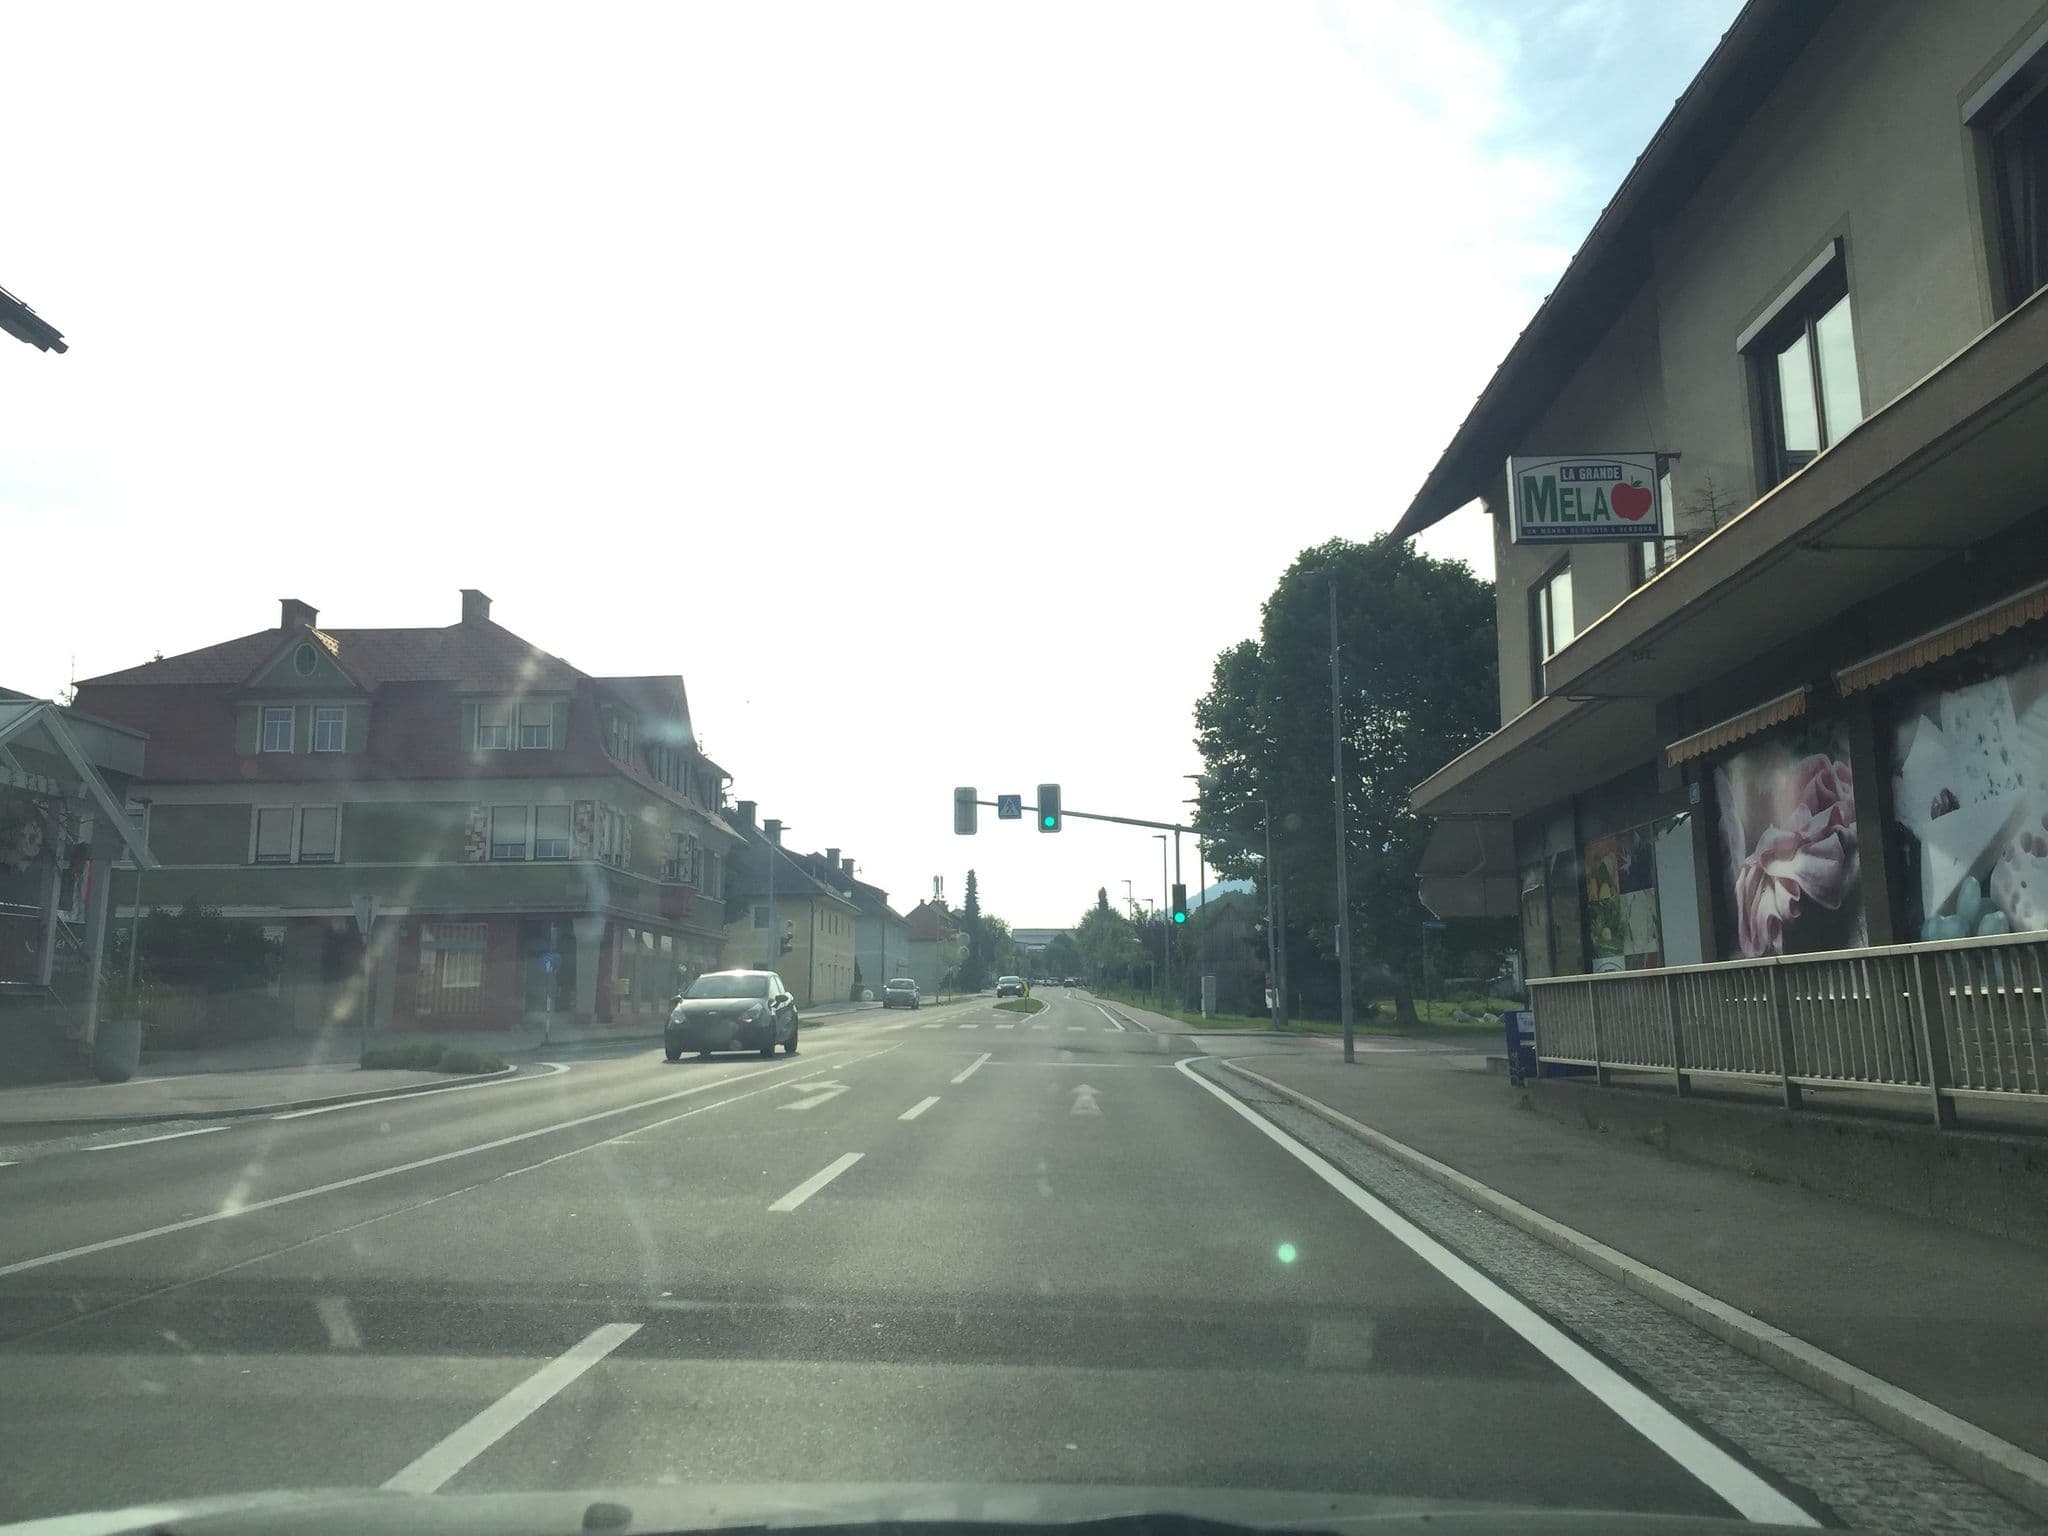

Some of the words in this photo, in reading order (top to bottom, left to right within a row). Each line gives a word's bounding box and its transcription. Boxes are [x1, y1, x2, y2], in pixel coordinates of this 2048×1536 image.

[1562, 468, 1575, 481] LA
[1580, 467, 1621, 480] GRANDE
[1523, 475, 1611, 522] MELA
